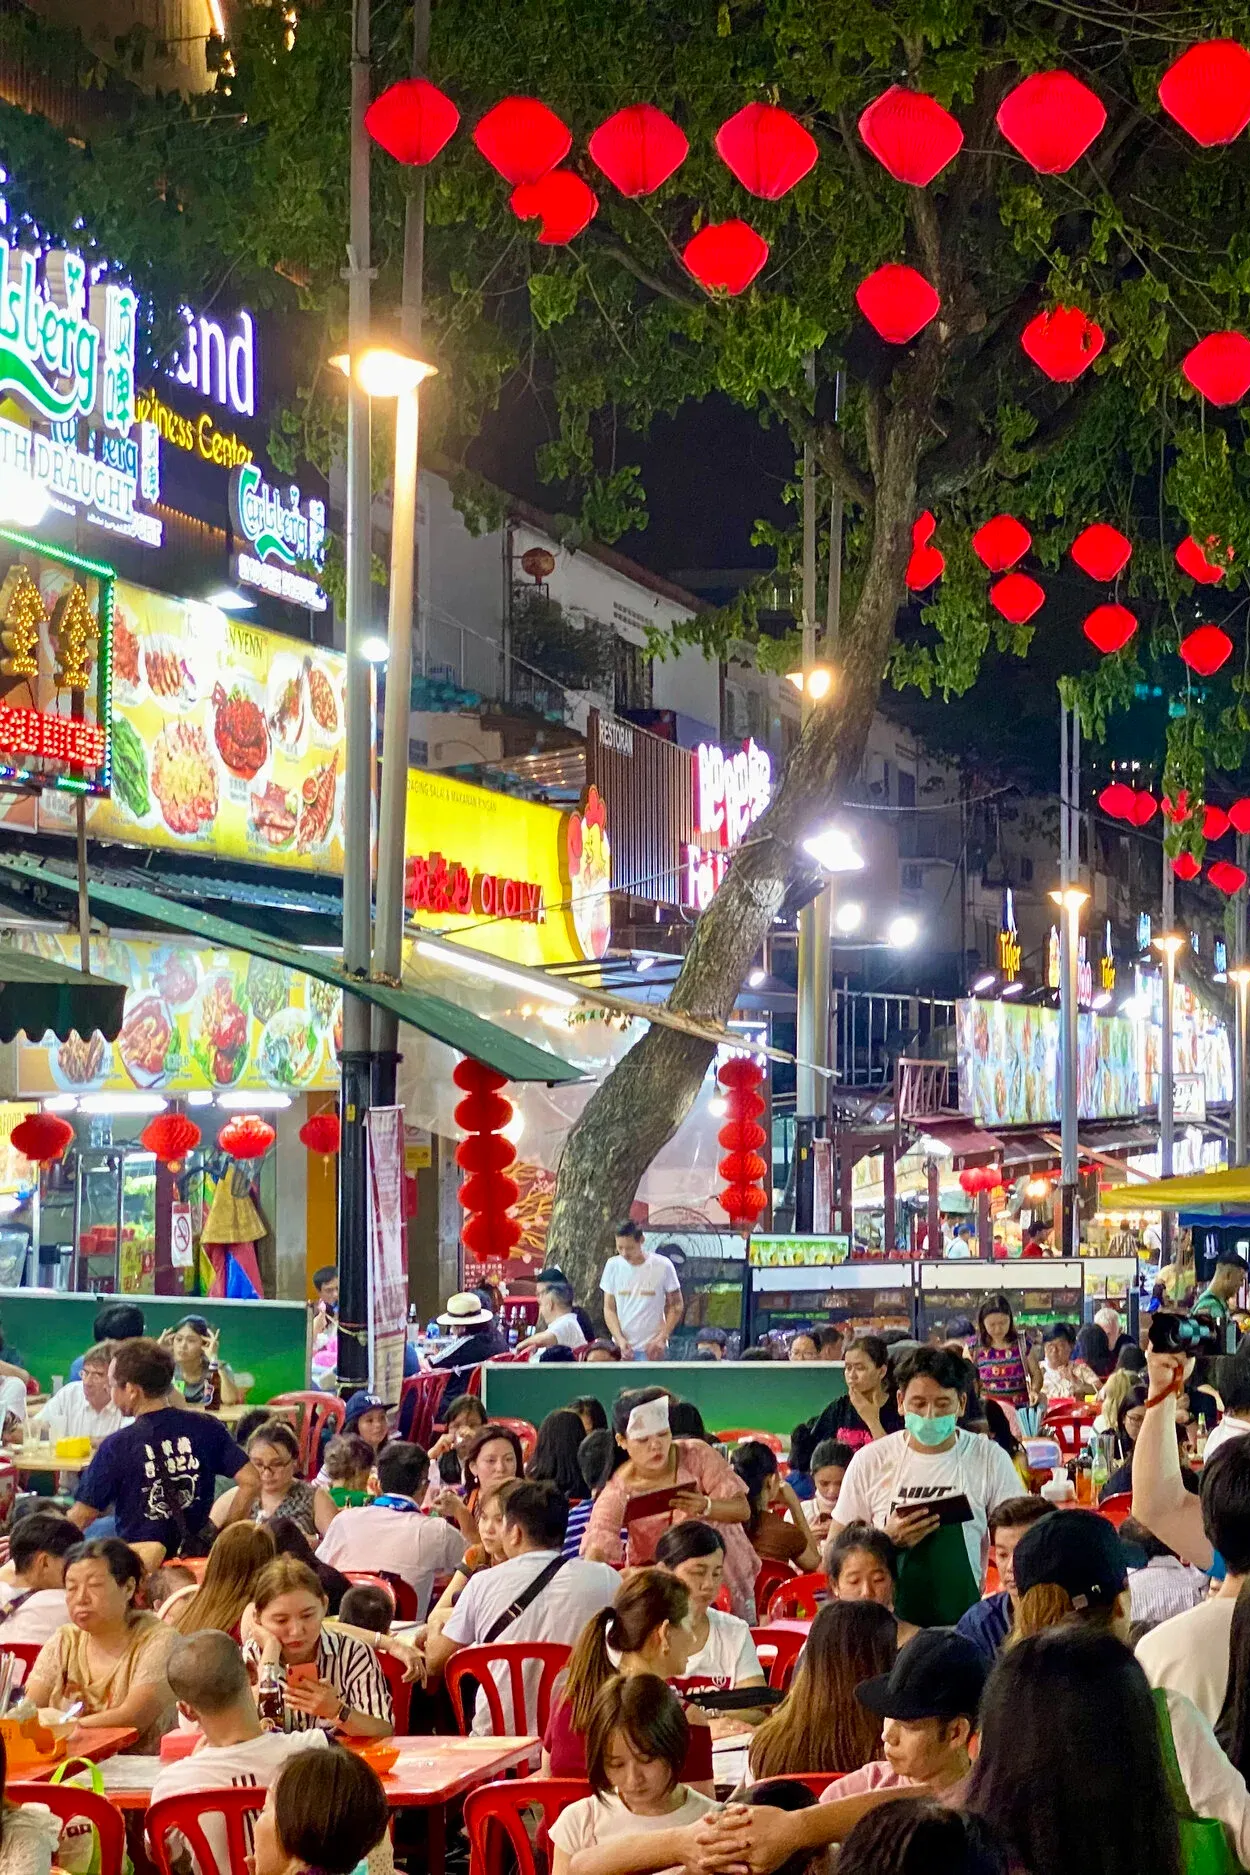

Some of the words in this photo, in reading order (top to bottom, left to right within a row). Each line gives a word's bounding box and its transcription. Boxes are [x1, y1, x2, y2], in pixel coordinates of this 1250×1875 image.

[198, 414, 254, 469] Center
[37, 443, 134, 517] DRAUGHT
[239, 462, 308, 560] Carlsberg
[599, 718, 634, 755] RESTORAN
